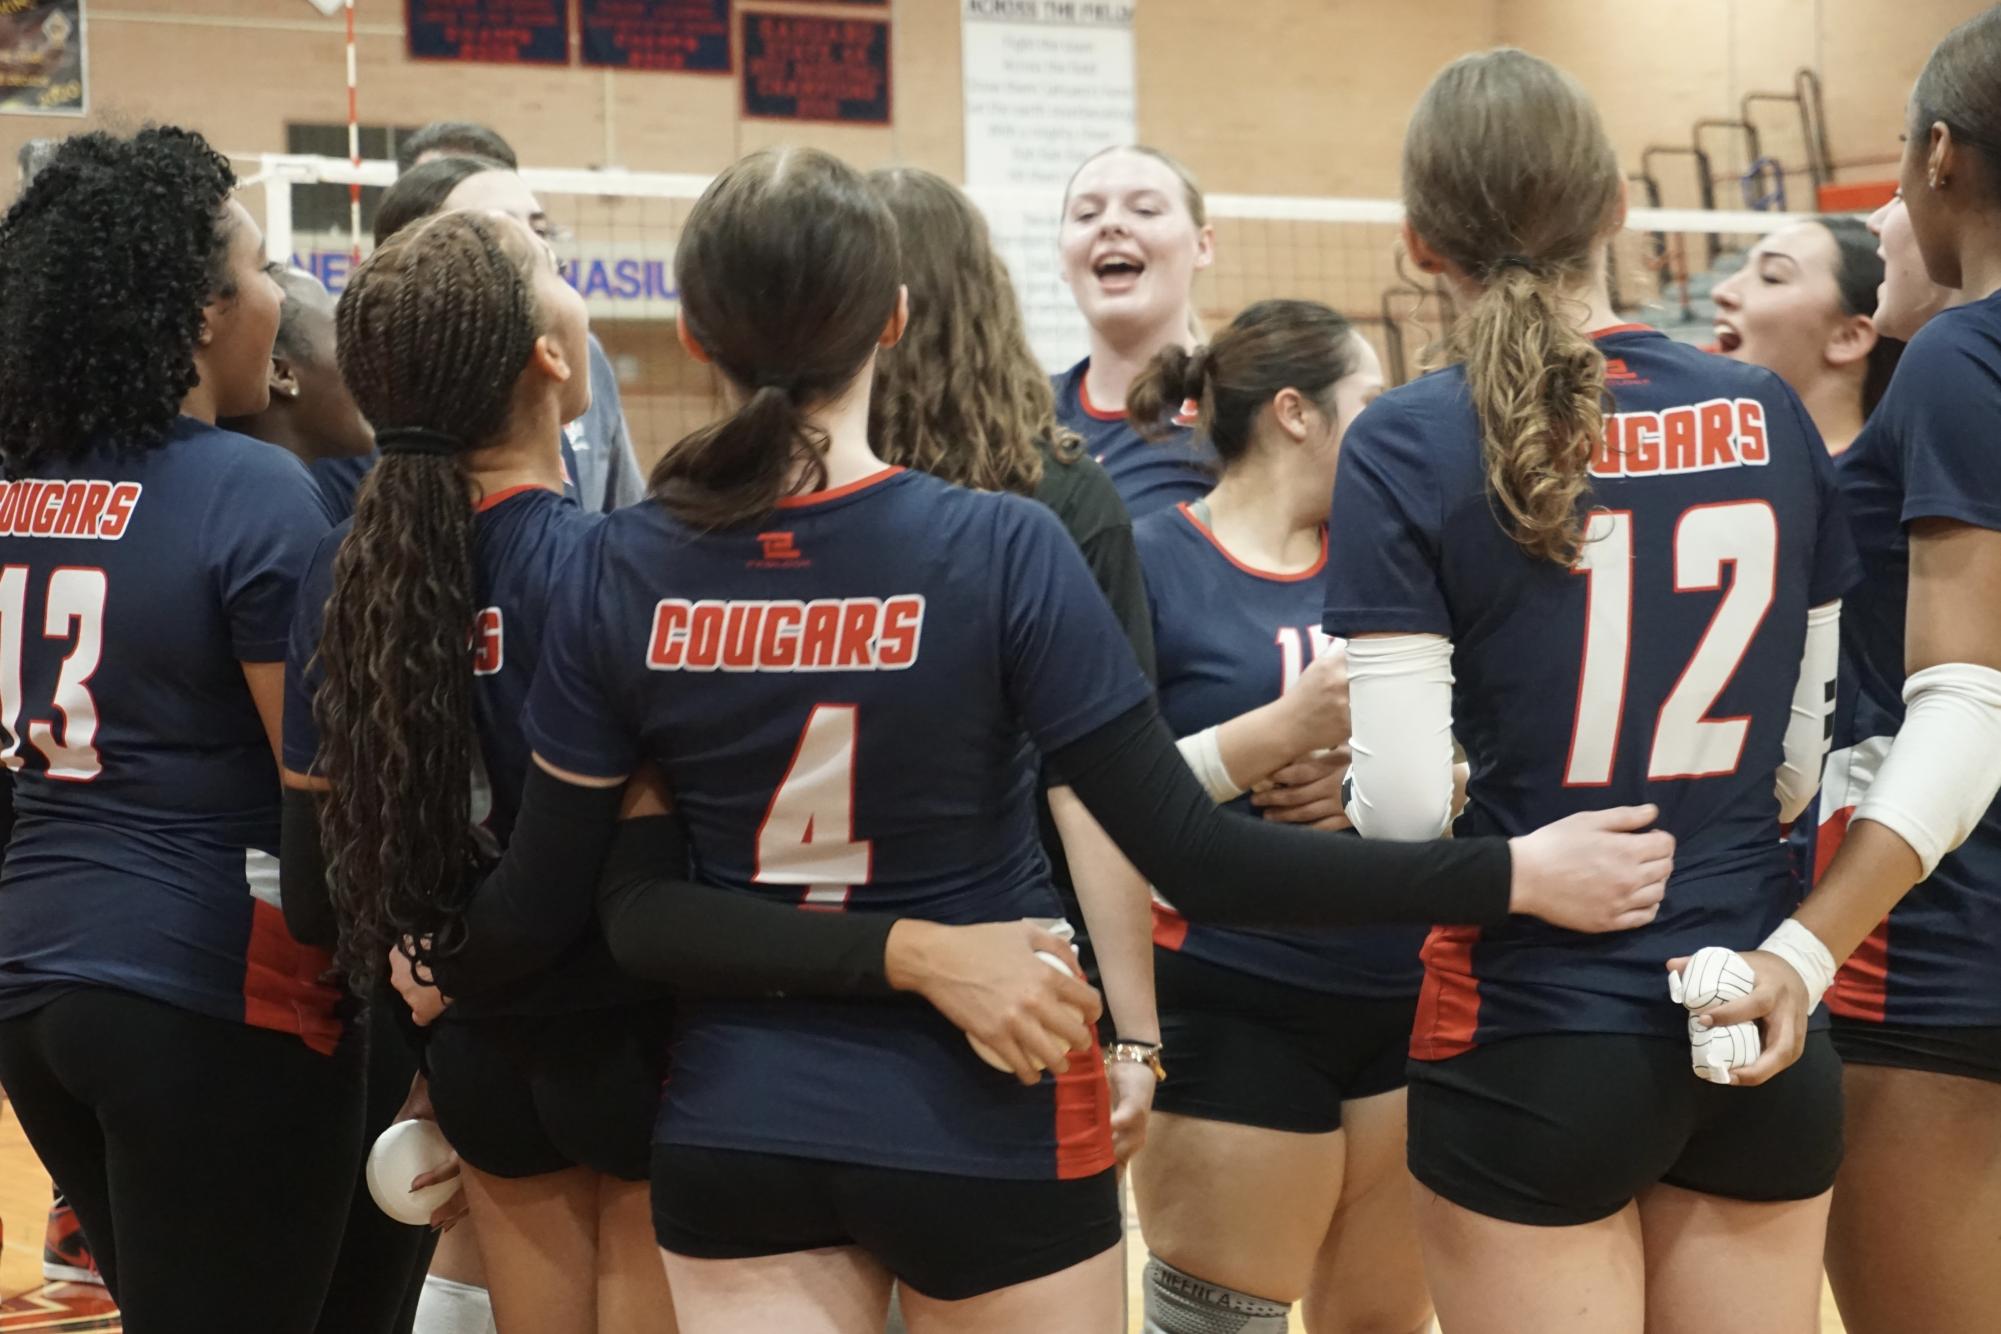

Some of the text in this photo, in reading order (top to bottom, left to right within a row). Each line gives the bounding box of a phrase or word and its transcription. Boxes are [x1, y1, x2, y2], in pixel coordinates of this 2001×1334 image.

[0, 479, 142, 540] OUGARS
[1587, 398, 1770, 478] UGARS
[0, 564, 109, 782] 13
[646, 593, 925, 672] COUGARS
[1562, 499, 1779, 788] 12
[750, 703, 874, 911] 4
